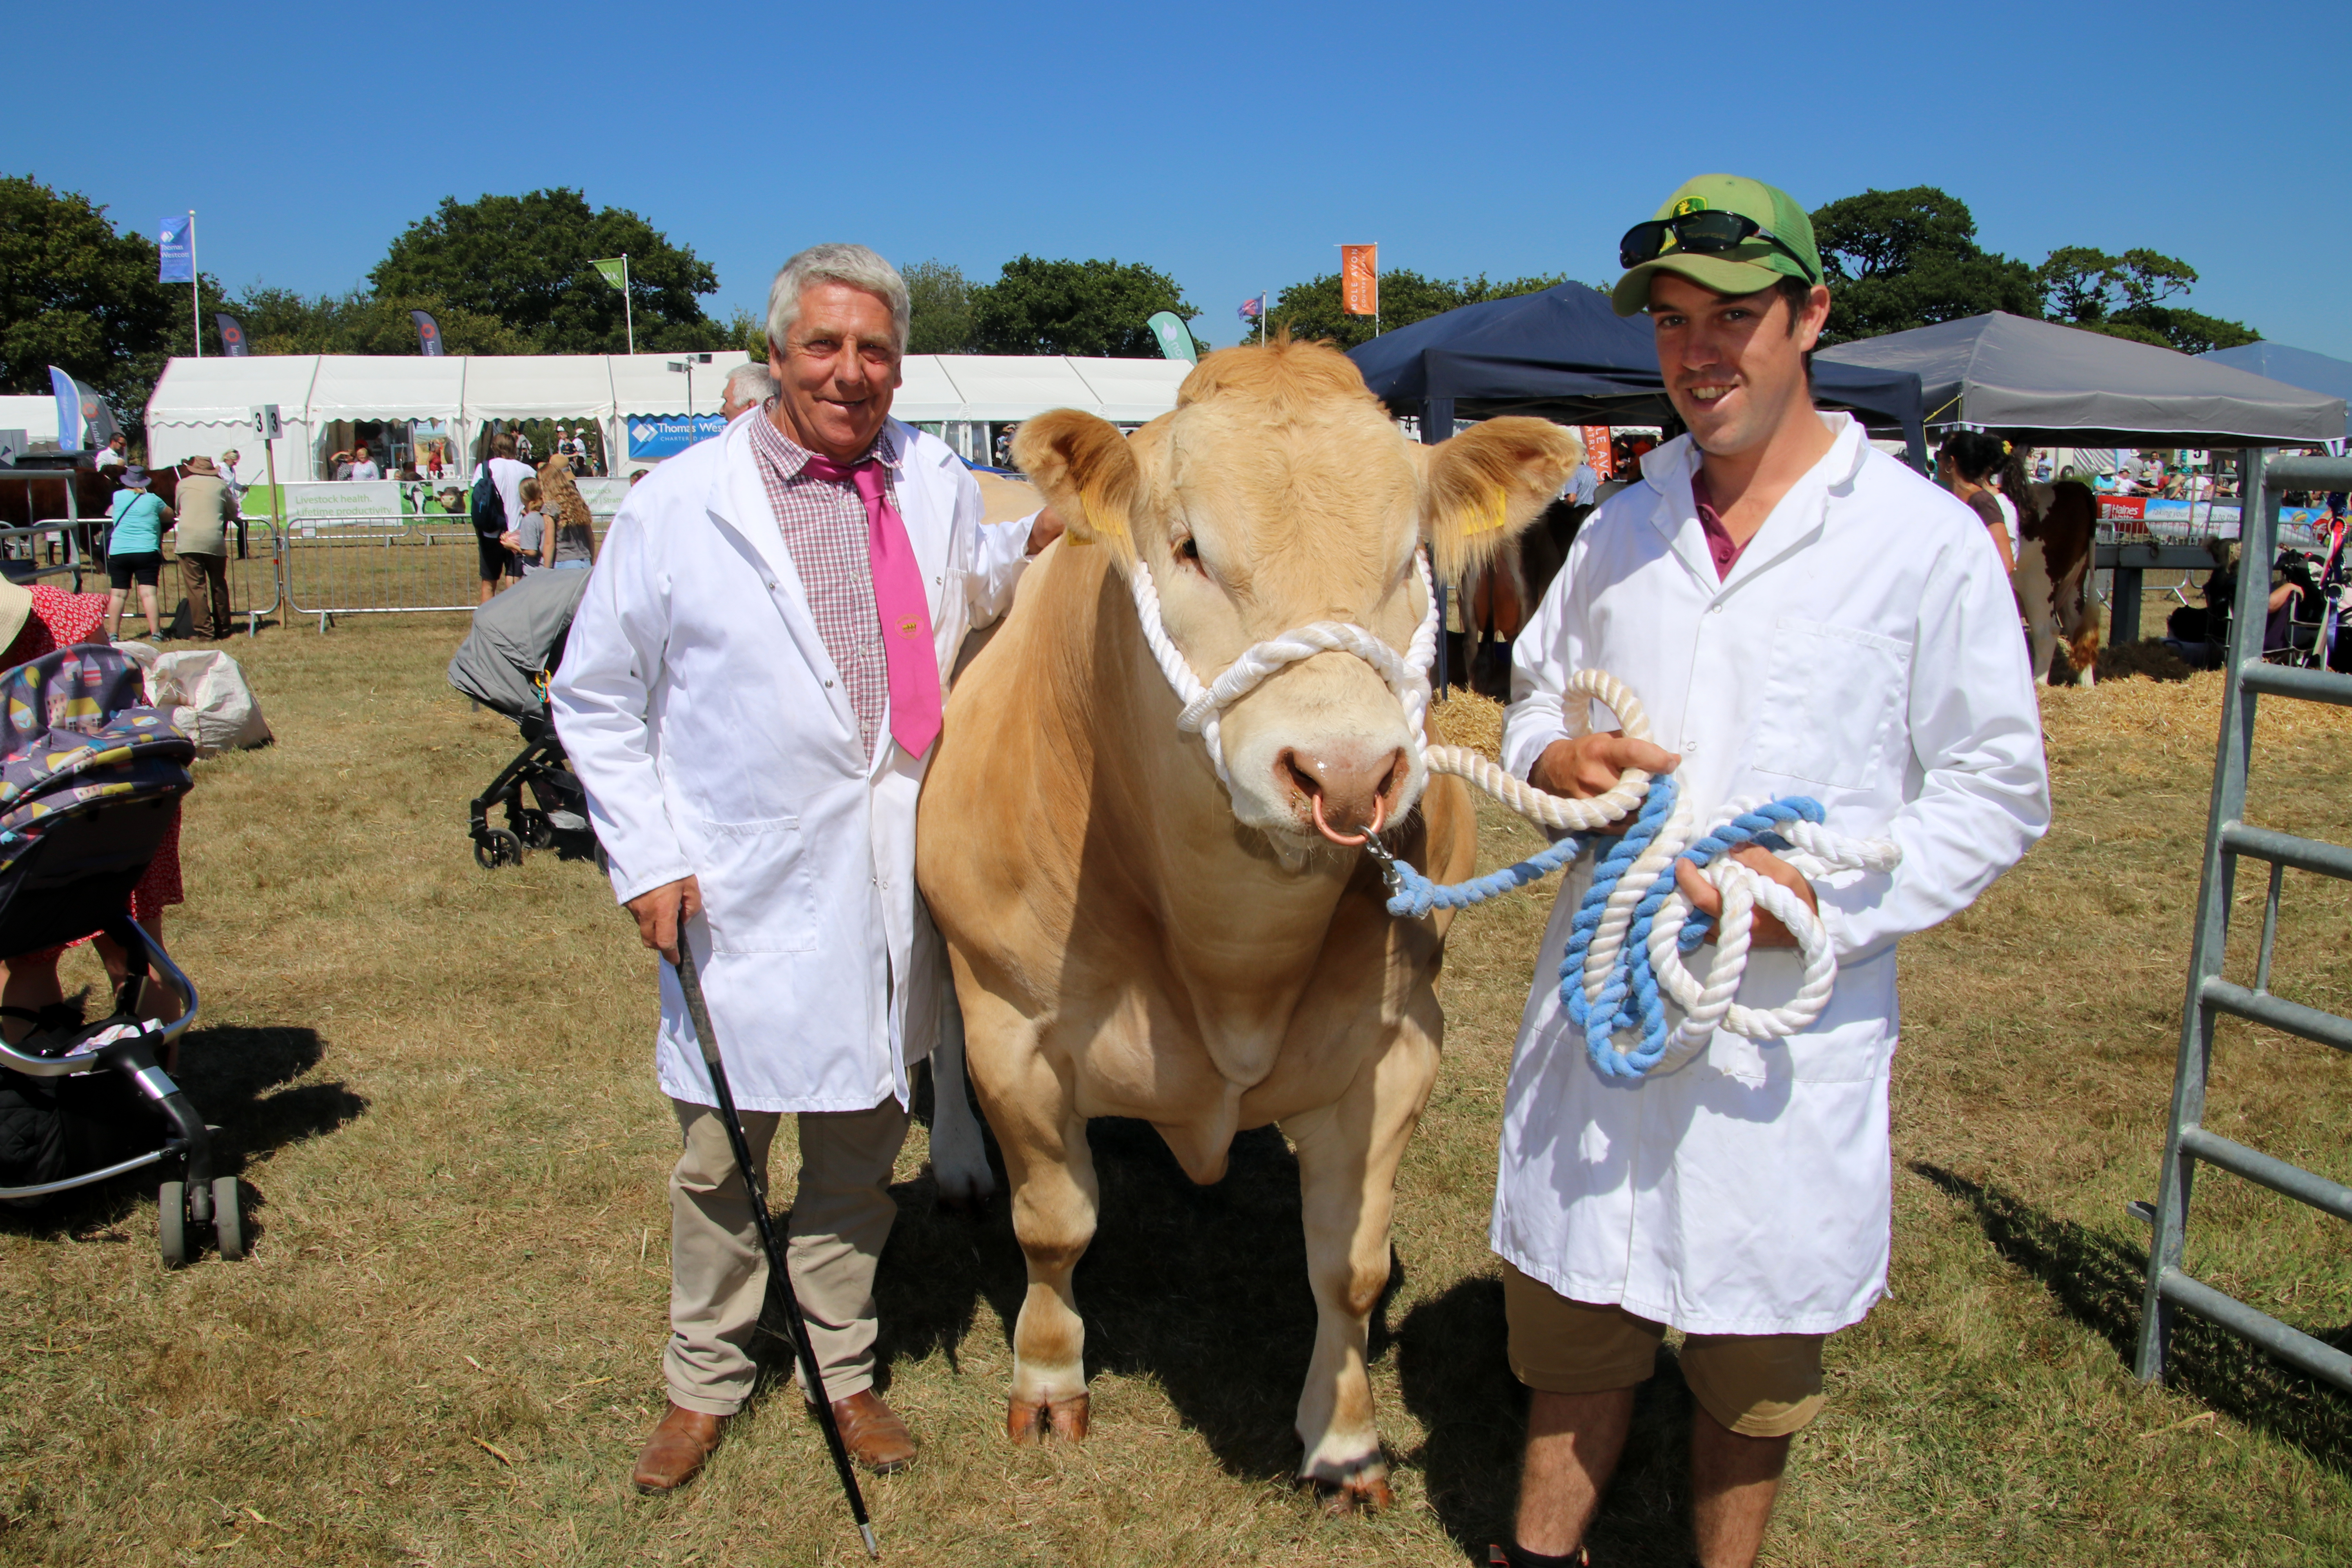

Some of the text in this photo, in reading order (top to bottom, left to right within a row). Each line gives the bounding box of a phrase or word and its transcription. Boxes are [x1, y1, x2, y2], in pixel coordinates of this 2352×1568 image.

[255, 412, 263, 432] 3
[271, 412, 278, 432] 3
[657, 423, 696, 433] Thomas
[1587, 426, 1595, 451] NTRY
[1596, 426, 1610, 481] LE AVO
[296, 494, 372, 504] Livestock health.
[297, 506, 394, 516] Lifetime productivity.
[2112, 504, 2139, 515] Haines
[2152, 509, 2171, 518] Taking
